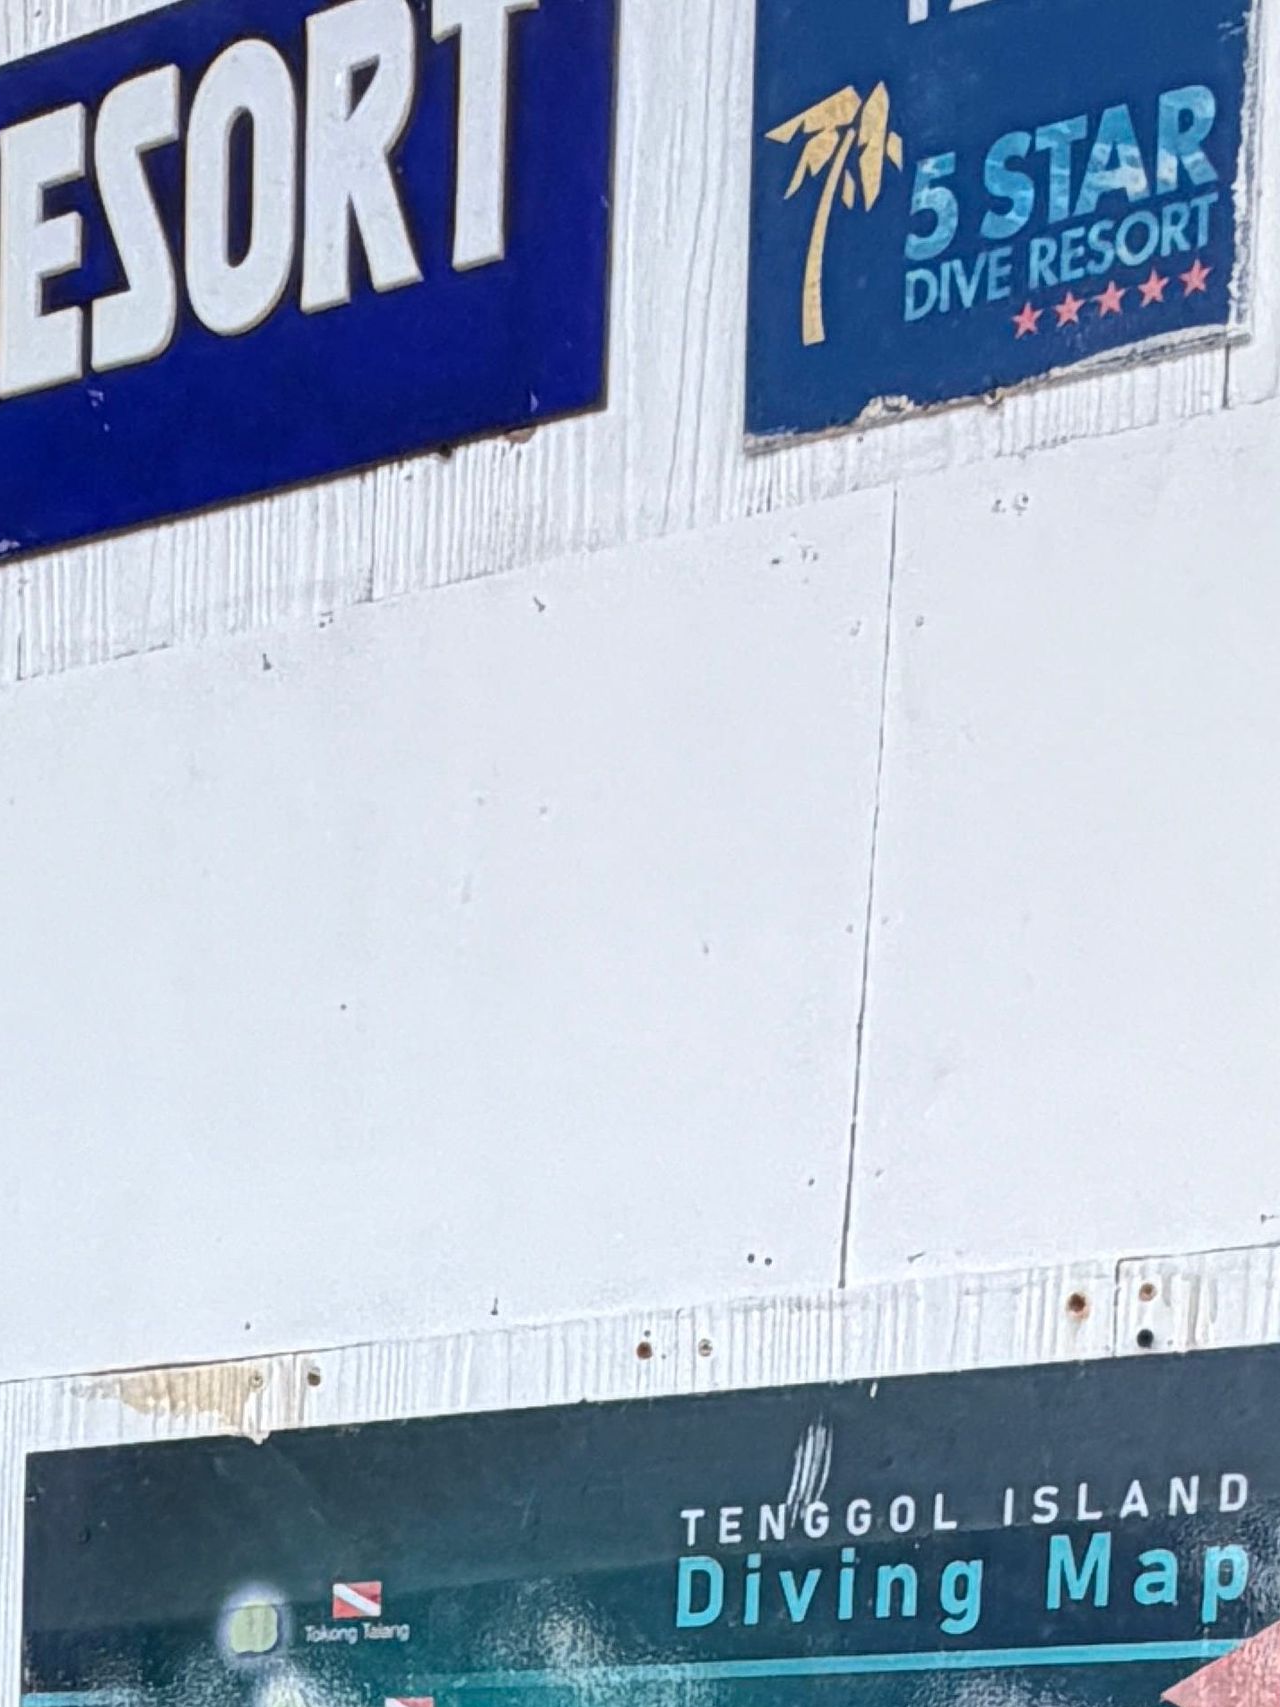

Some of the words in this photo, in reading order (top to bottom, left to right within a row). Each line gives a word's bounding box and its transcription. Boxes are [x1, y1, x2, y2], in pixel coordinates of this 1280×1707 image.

[904, 151, 960, 262] 5
[980, 84, 1219, 240] STAR
[904, 245, 1012, 323] DIVE
[1028, 192, 1219, 289] RESORT
[679, 1493, 958, 1547] TENGGOL
[1003, 1473, 1250, 1526] ISLAND
[676, 1546, 984, 1635] Diving
[1046, 1531, 1250, 1626] Map
